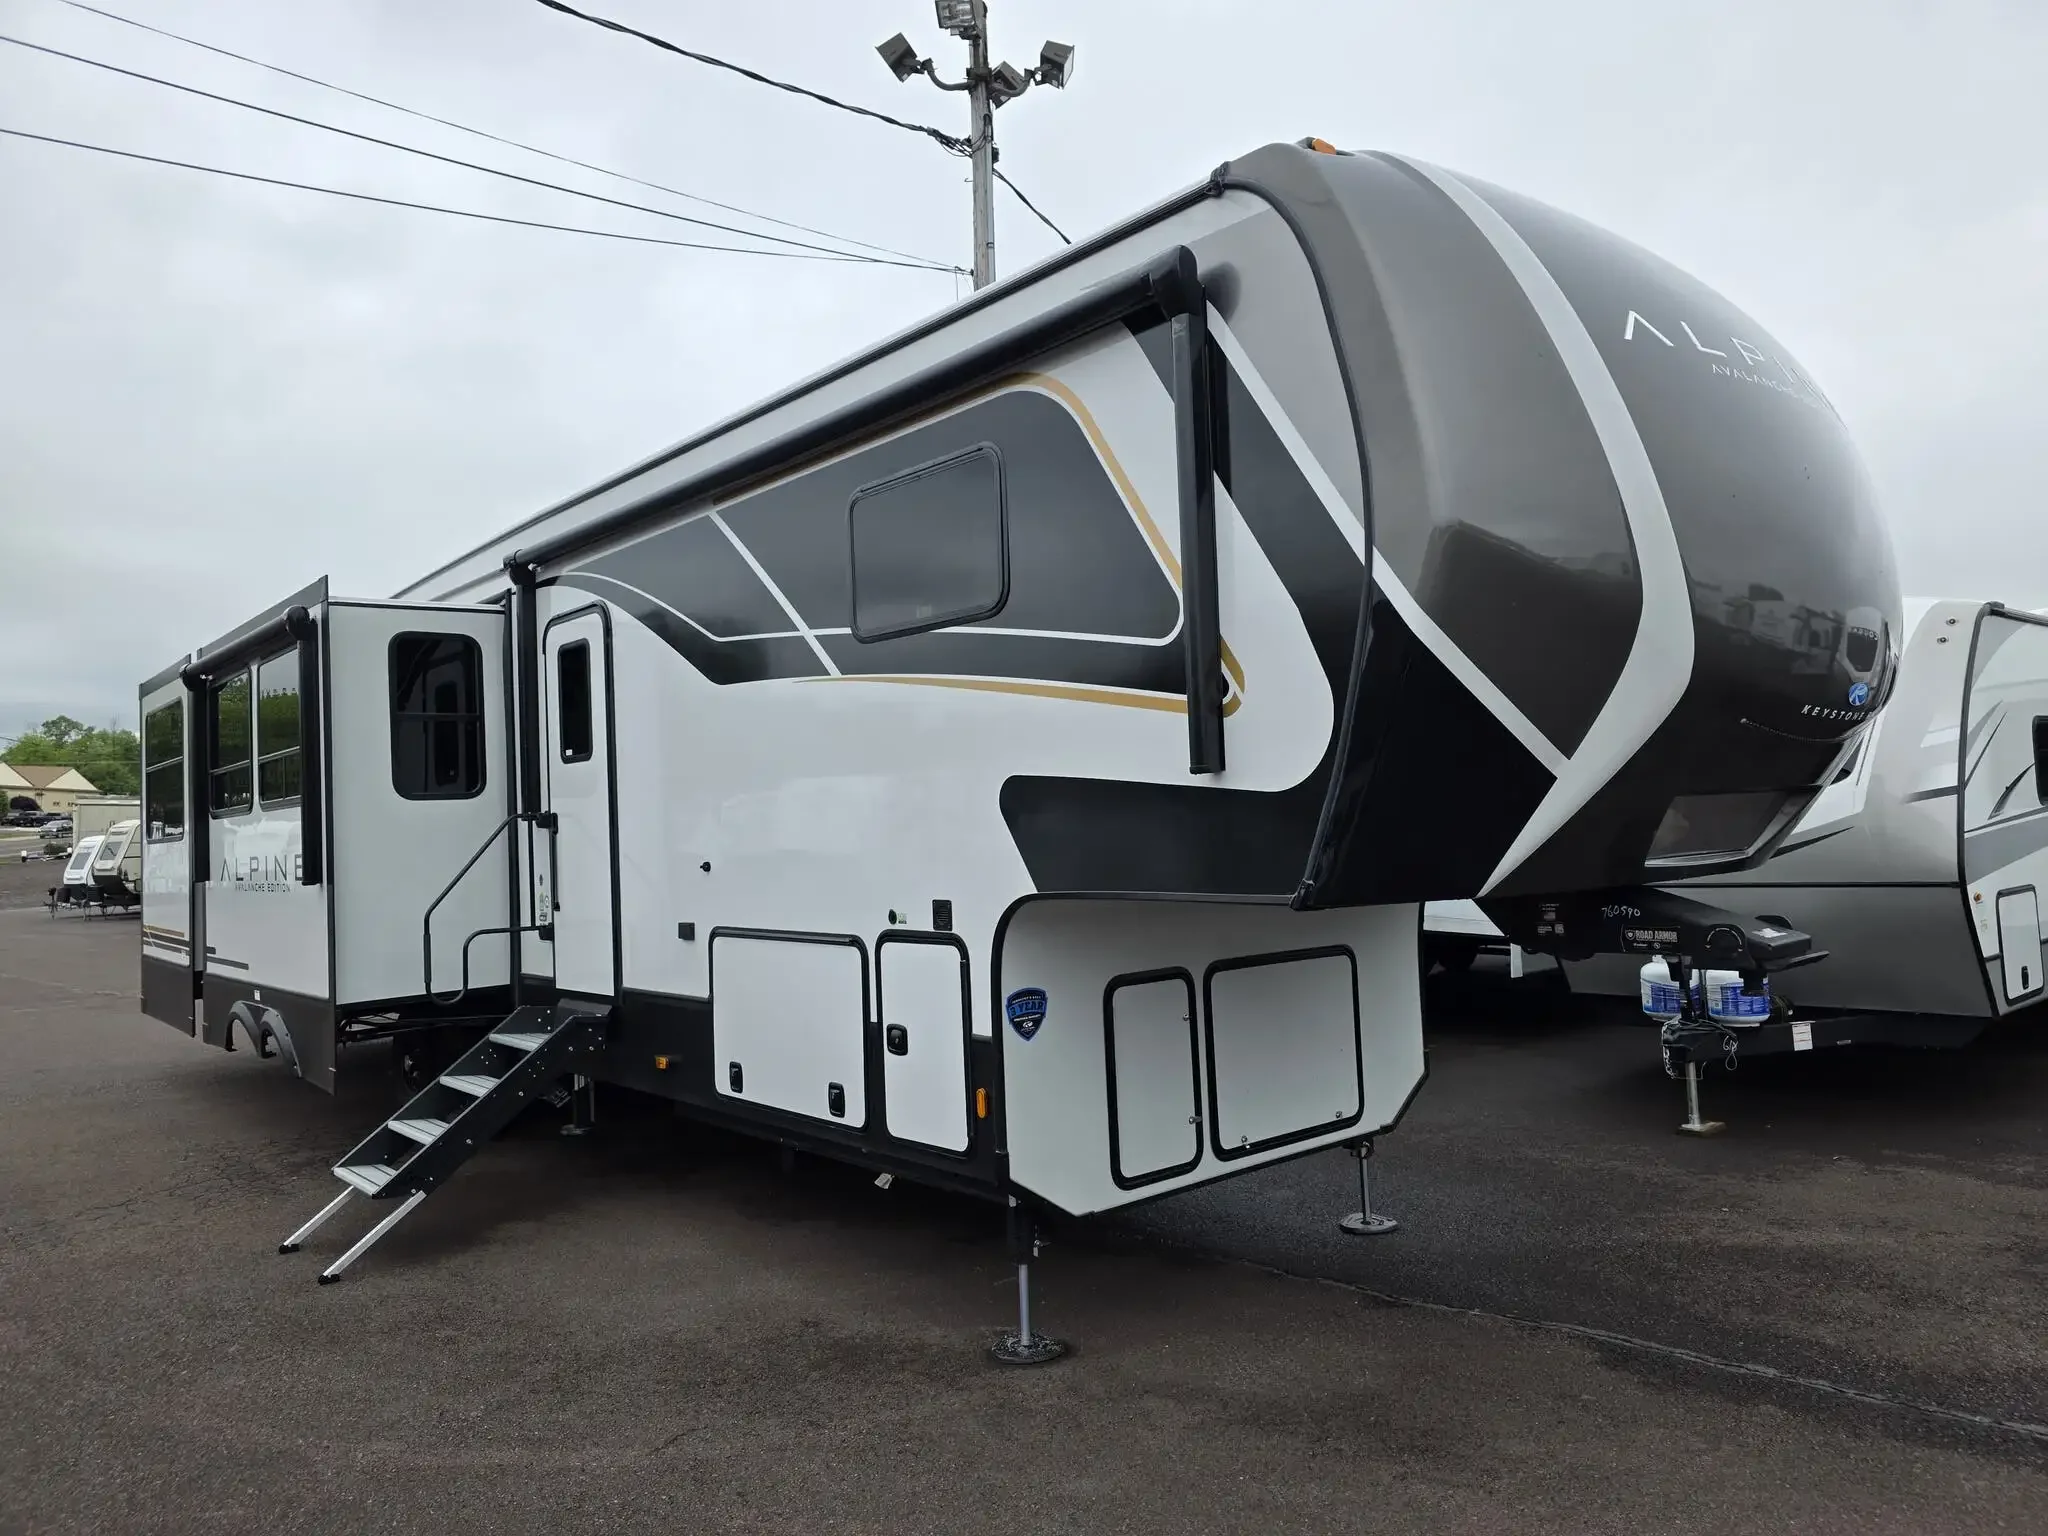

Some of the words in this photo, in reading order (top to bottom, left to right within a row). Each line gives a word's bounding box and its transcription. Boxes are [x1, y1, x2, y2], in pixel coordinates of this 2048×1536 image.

[1624, 310, 1848, 430] ALPIN
[220, 854, 303, 882] ALPINE
[1635, 930, 1653, 940] ROAD
[1654, 930, 1678, 940] ARMOR
[1018, 1001, 1044, 1013] YEAR
